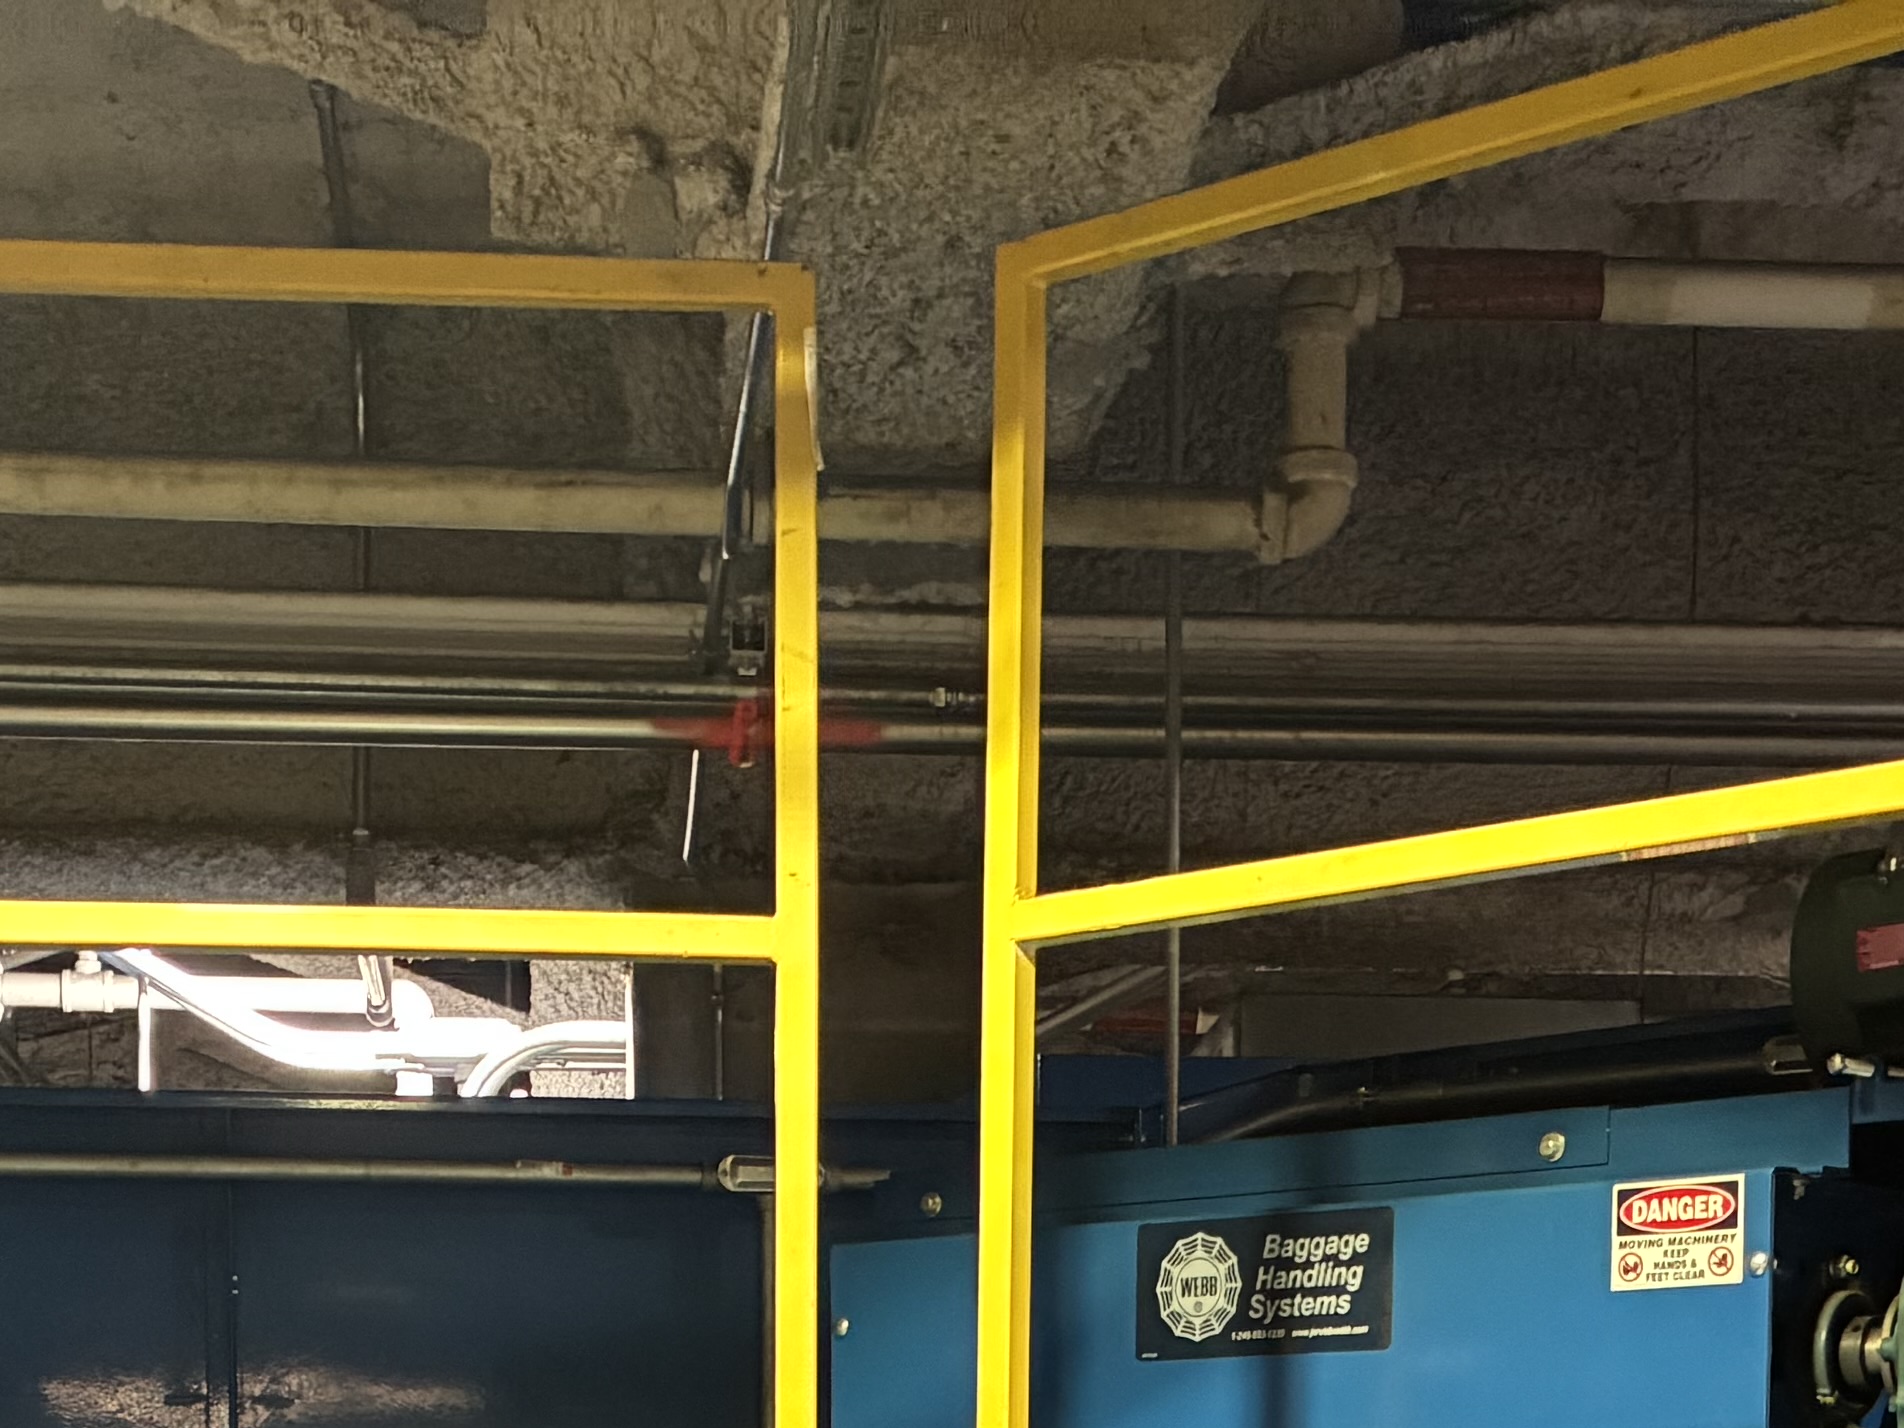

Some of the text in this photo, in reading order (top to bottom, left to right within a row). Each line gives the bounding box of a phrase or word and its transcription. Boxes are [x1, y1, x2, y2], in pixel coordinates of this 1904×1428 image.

[1631, 1193, 1724, 1224] DANGER
[1262, 1232, 1371, 1263] Baggage
[1618, 1233, 1738, 1250] MOVING MACHINERY
[1179, 1275, 1218, 1299] WEBB
[1255, 1262, 1364, 1292] Handling
[1673, 1269, 1706, 1281] CLEAR
[1248, 1293, 1352, 1325] Systems
